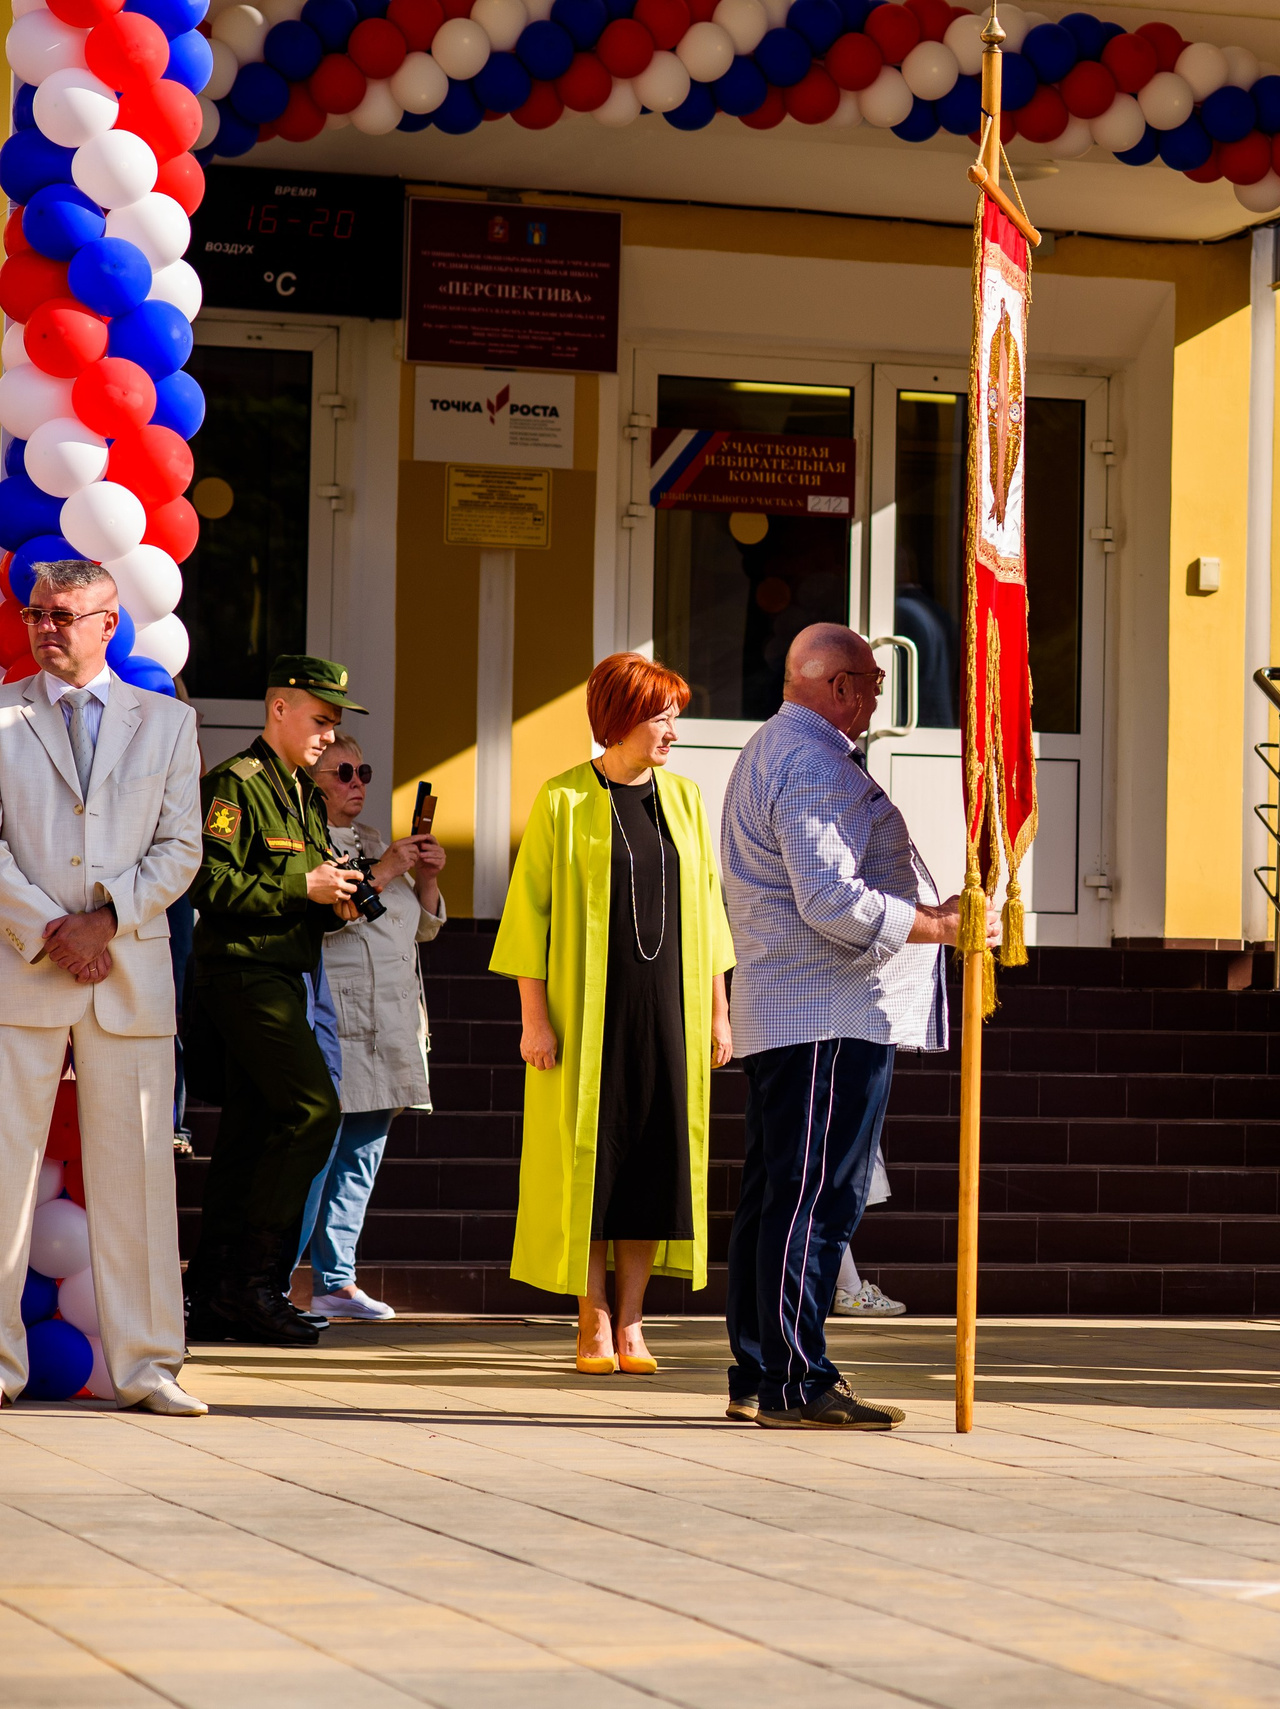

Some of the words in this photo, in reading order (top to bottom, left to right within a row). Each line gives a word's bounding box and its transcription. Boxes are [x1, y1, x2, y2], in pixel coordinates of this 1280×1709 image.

[274, 185, 317, 198] ВРЕМЯ
[247, 204, 355, 239] 16-20
[204, 241, 255, 255] ВОЗДУХ
[438, 281, 592, 303] «ПЕРСПЕКТИВА»
[430, 399, 483, 413] ТОЧКА
[509, 404, 559, 417] РОСТА
[720, 440, 830, 458] УЧАСТКОВАЯ
[705, 454, 846, 473] ИЗБИРАТЕЛЬНАЯ
[729, 470, 821, 486] КОМИССИЯ
[750, 496, 794, 507] УЧАСТКА
